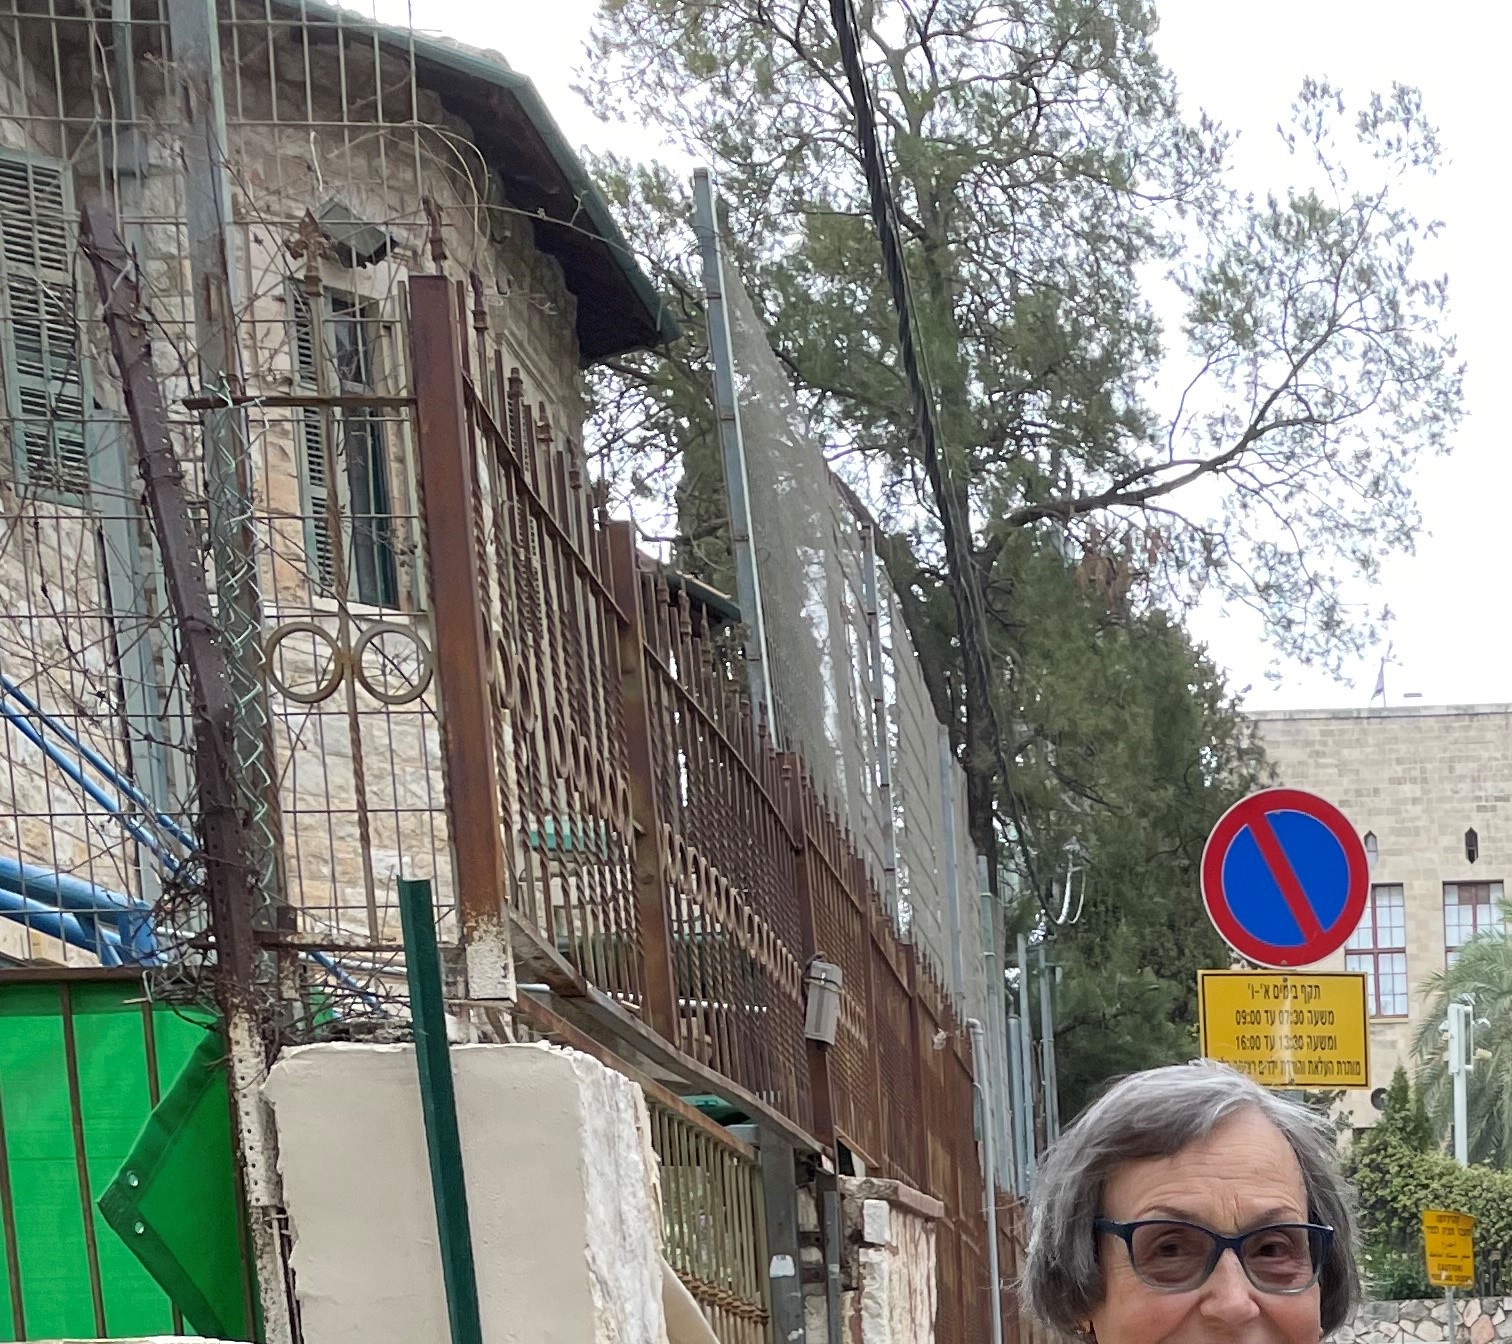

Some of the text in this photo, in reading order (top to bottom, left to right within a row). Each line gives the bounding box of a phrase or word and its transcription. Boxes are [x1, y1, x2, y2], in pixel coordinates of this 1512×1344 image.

[1273, 983, 1299, 1000] בימים
[1301, 983, 1321, 1004] תקף
[1235, 1009, 1335, 1028] משעה 07:30 עד 09:00
[1235, 1034, 1261, 1051] 16:00
[1264, 1034, 1276, 1051] עד
[1306, 1034, 1338, 1052] ומשעה
